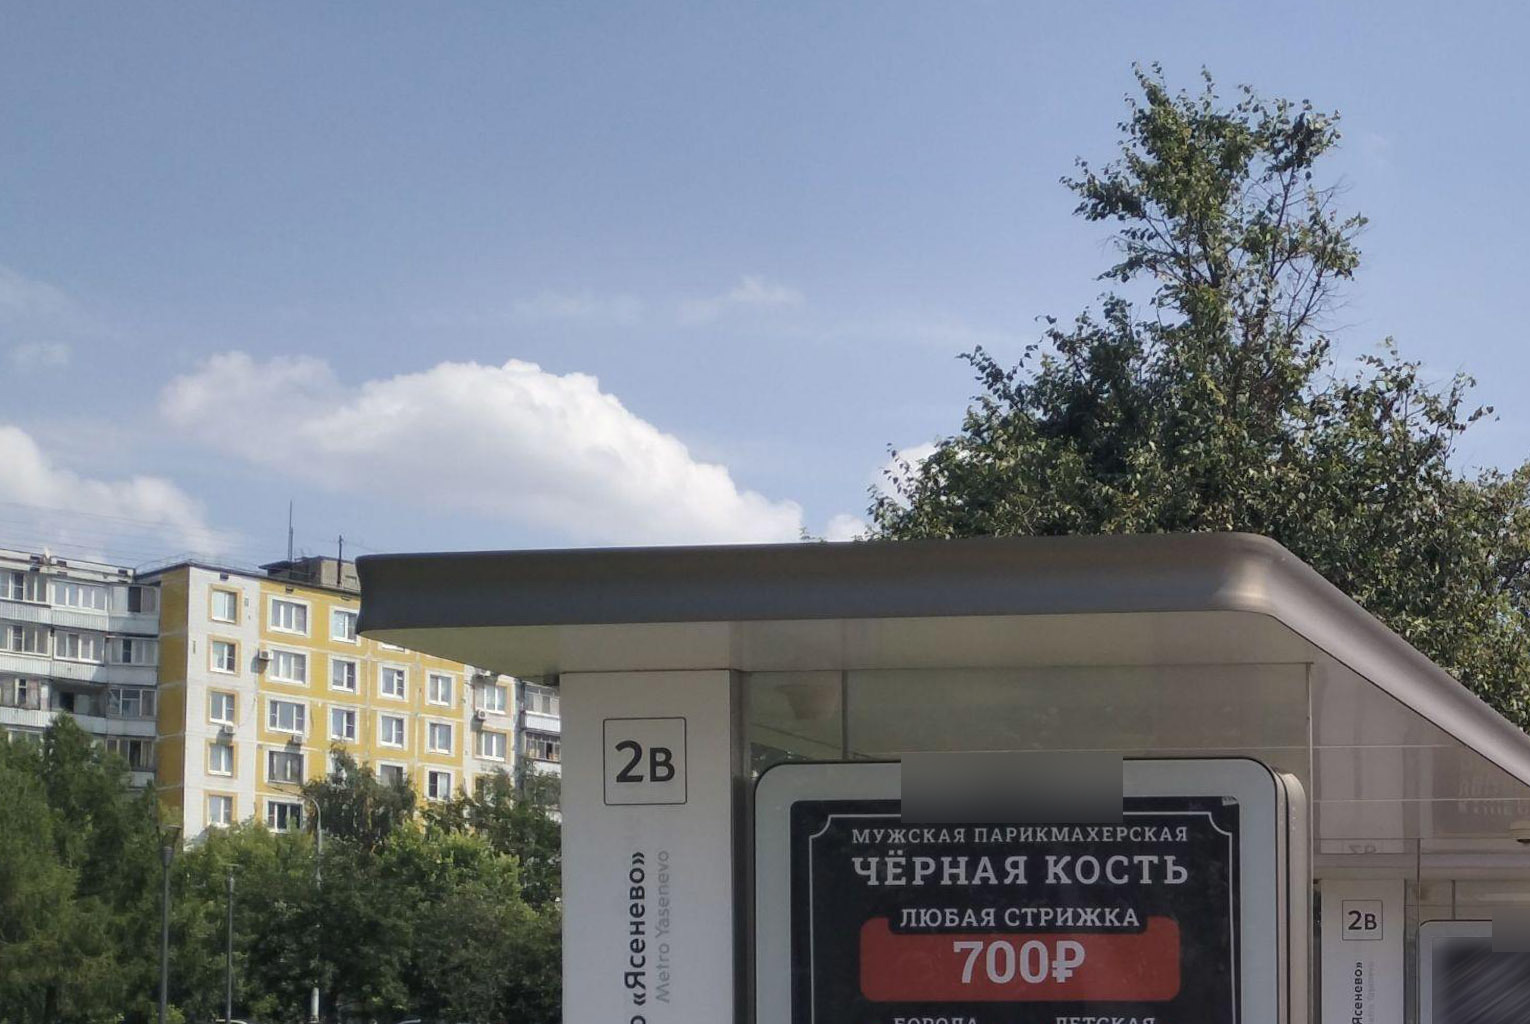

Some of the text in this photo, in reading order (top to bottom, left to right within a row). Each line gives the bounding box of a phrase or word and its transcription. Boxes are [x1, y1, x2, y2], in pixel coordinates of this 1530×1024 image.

[851, 826, 1188, 844] МУЖСКАЯ ПАРИКМАХЕРСКАЯ
[851, 849, 1189, 886] ЧЁРНАЯ КОСТЬ
[624, 851, 647, 1007] «Ясенево»
[655, 849, 671, 1004] Metro Yasenevo
[900, 907, 1140, 928] ЛЮБАЯ СТРИЖКА
[952, 939, 1086, 985] 700₽
